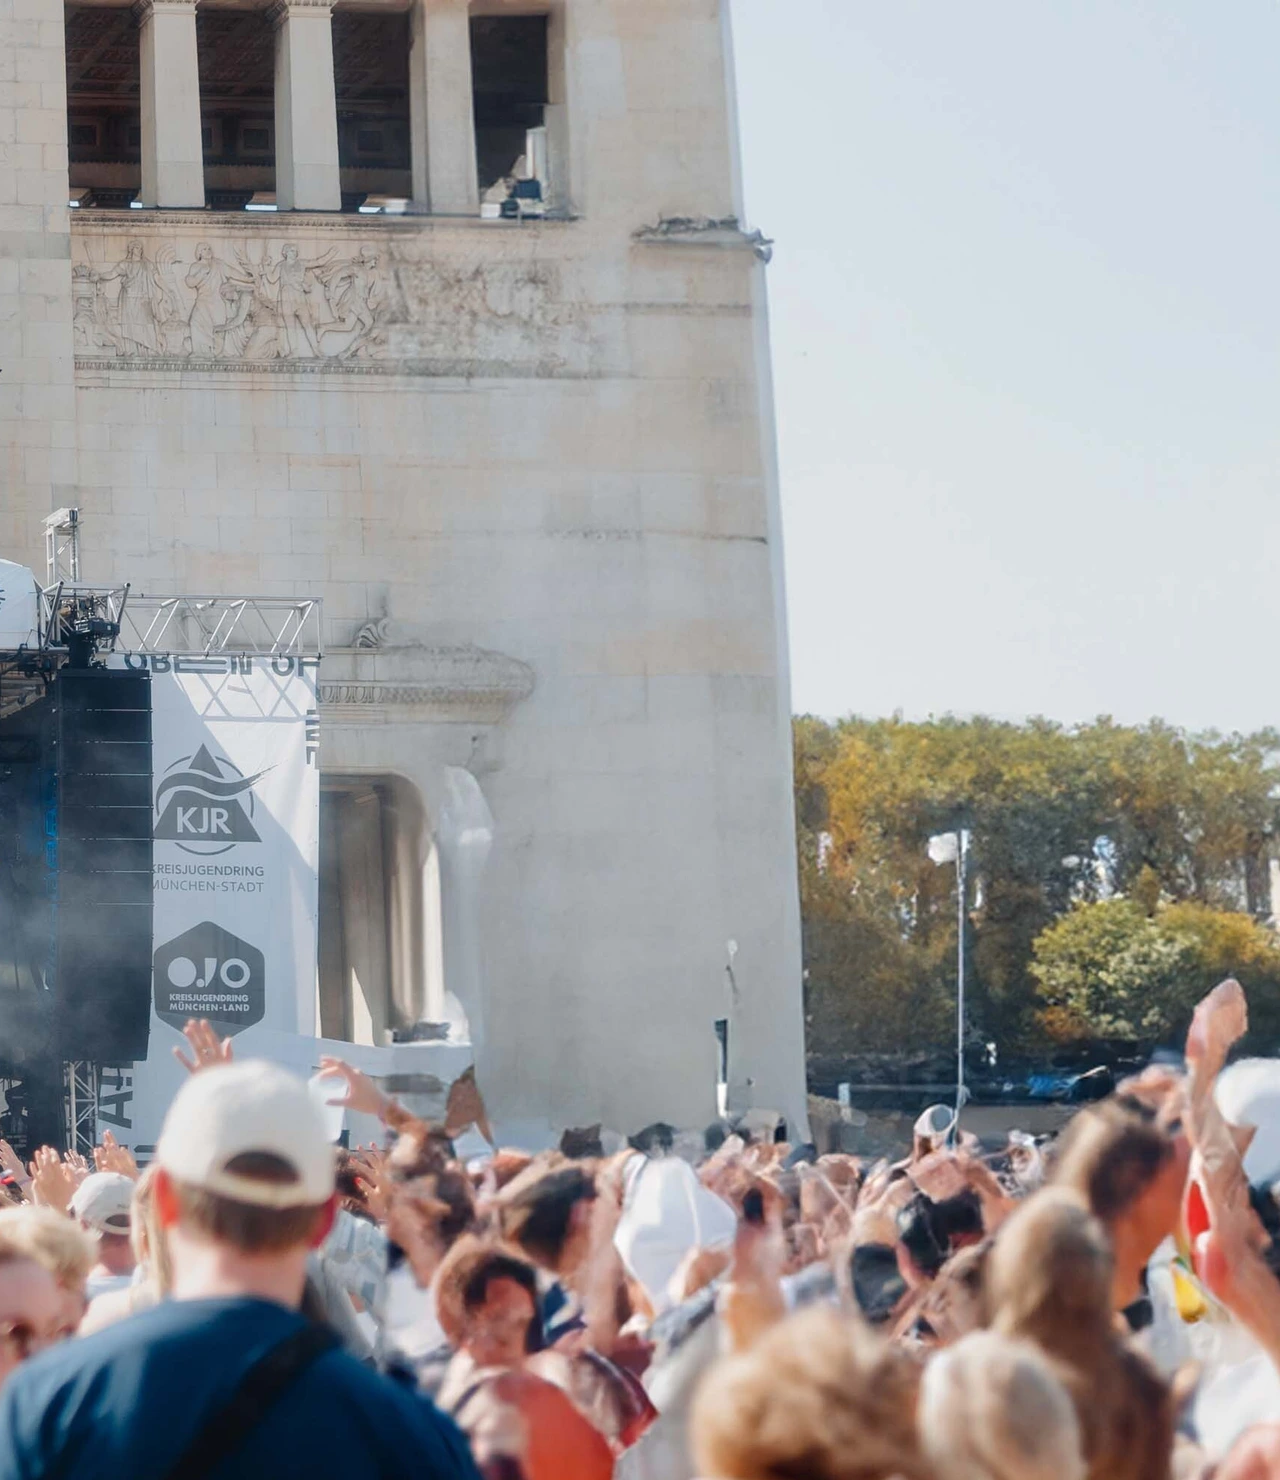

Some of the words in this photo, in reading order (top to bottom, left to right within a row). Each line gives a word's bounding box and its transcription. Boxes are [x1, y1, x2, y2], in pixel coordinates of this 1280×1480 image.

[176, 806, 233, 834] KJR
[169, 993, 250, 1003] KREISJUGENDRING
[169, 1001, 251, 1012] MÜNCHEN-LAND
